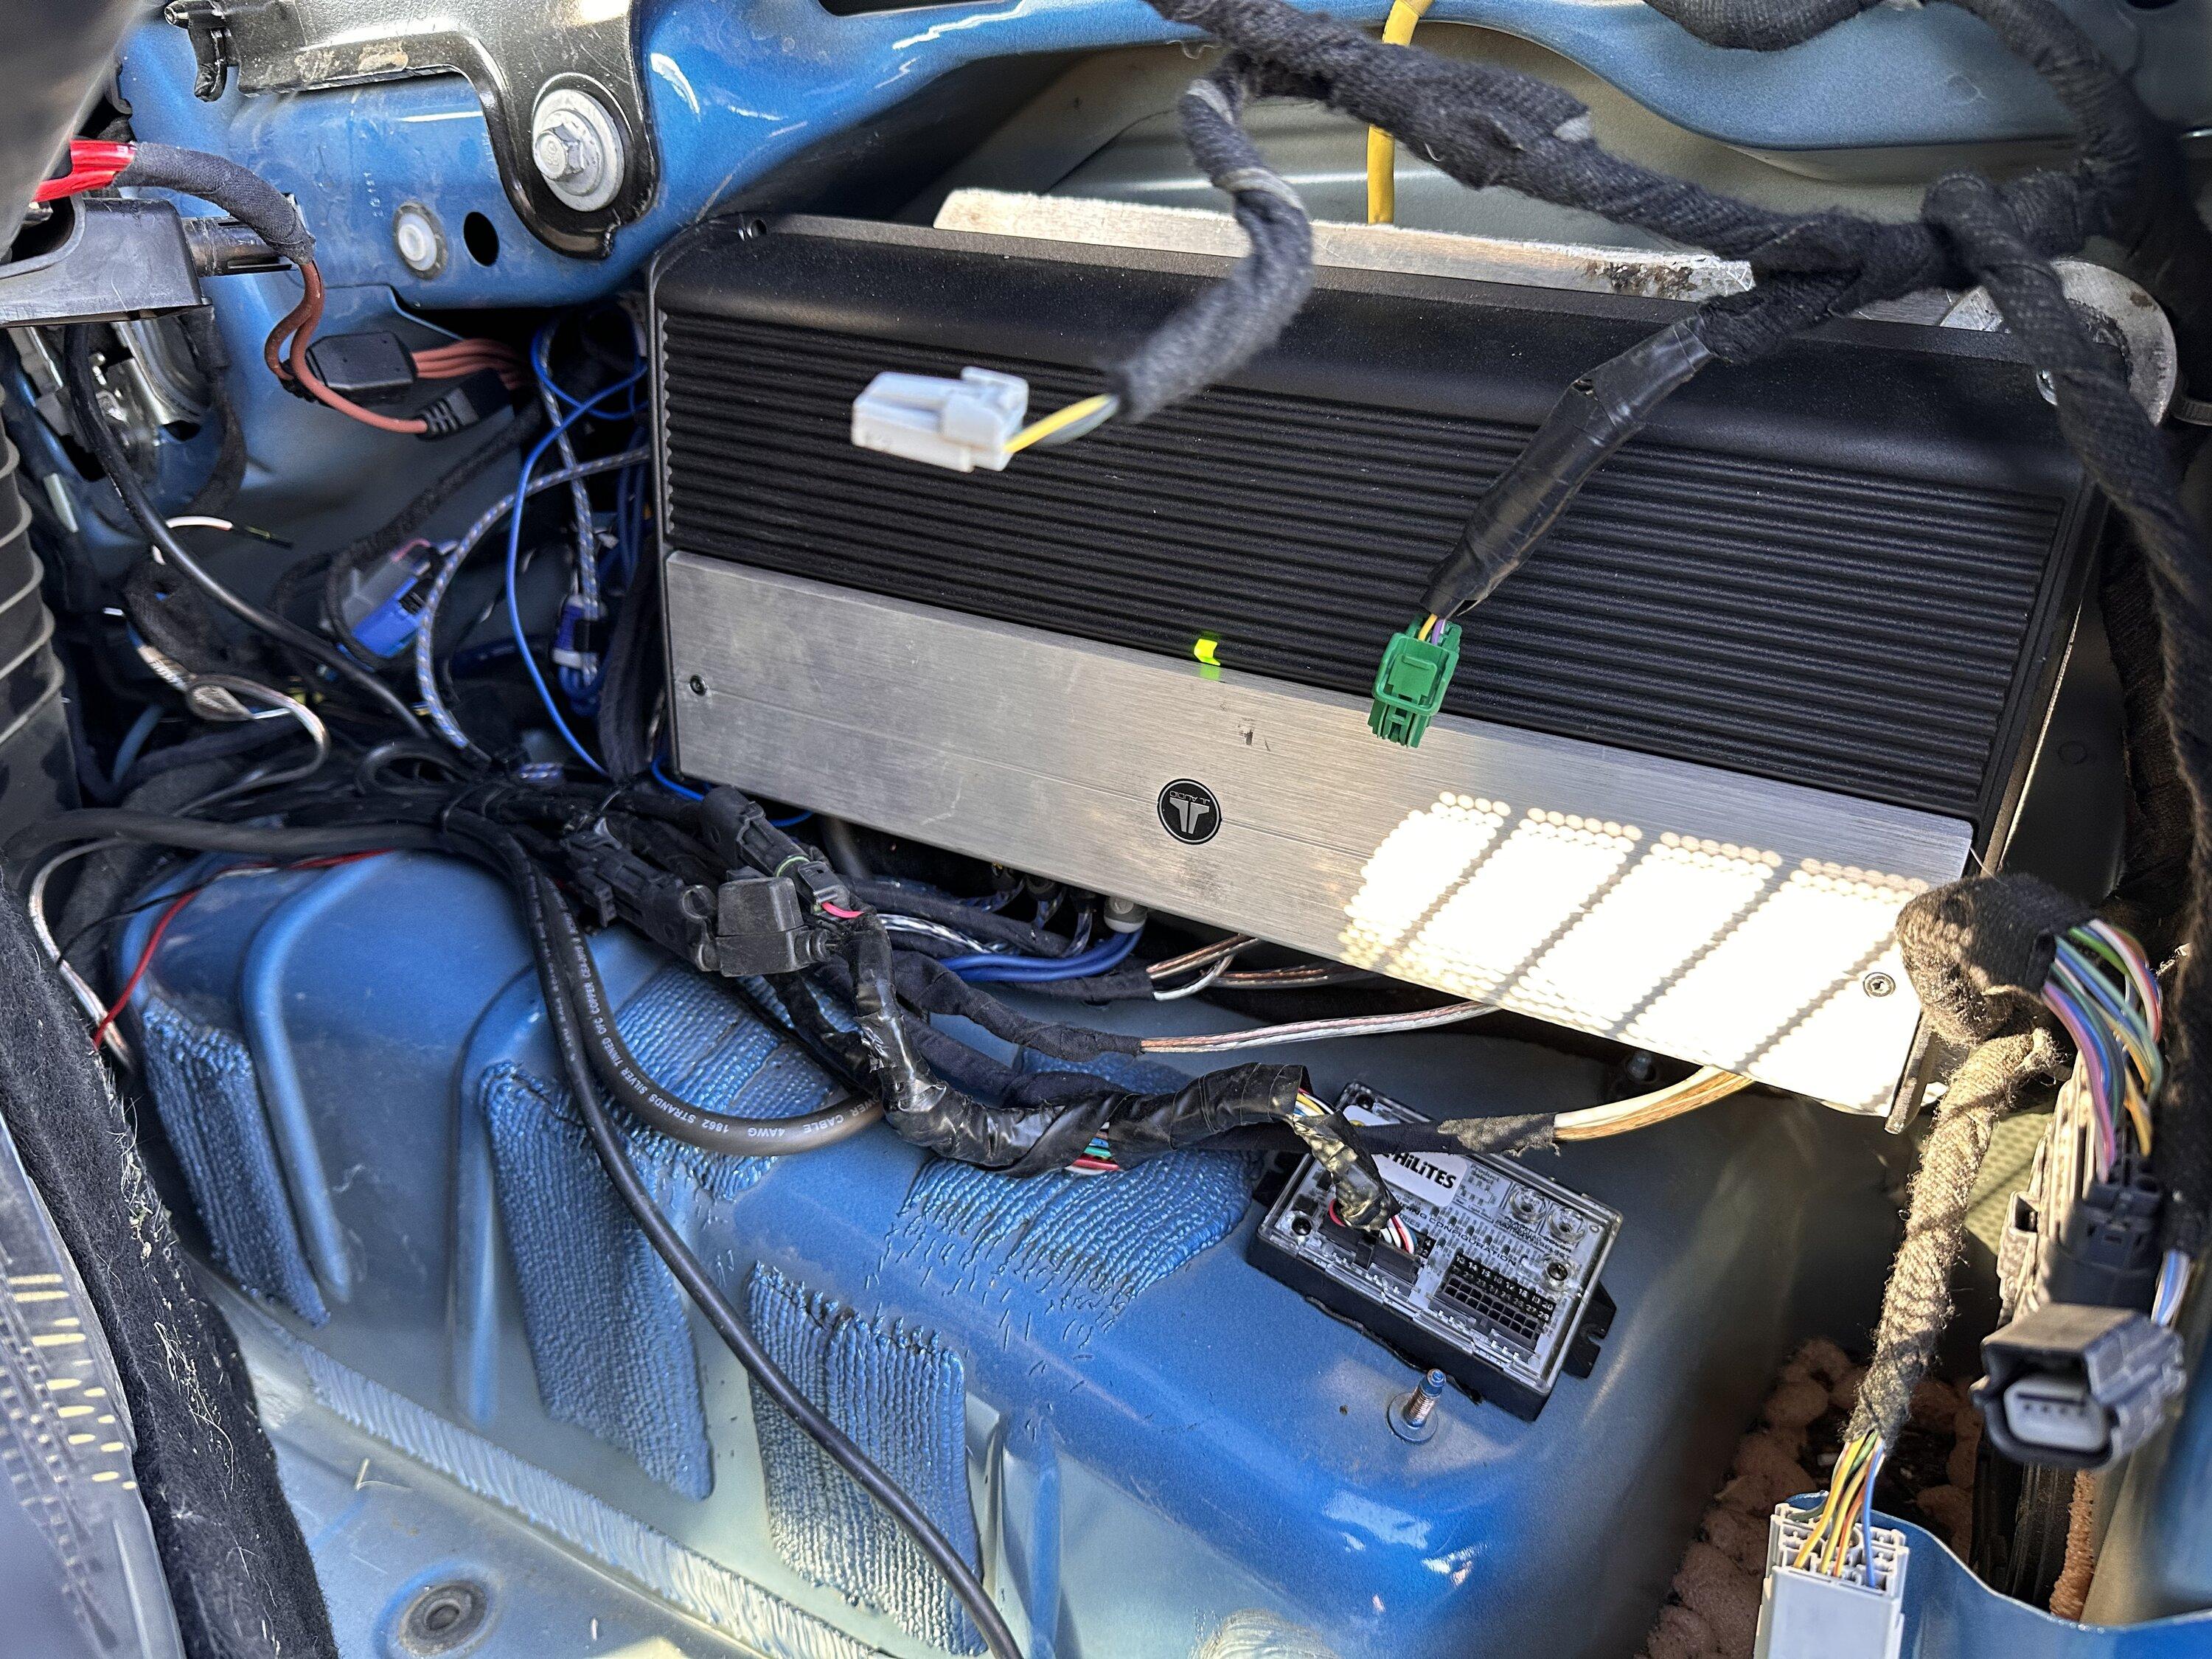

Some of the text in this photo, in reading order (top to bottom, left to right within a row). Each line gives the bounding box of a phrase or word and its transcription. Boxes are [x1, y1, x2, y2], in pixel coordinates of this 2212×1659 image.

[1169, 790, 1198, 801] AUDIO
[582, 981, 602, 1015] COPPER
[593, 1017, 608, 1035] OFC
[602, 1035, 625, 1068] TINNED
[619, 1066, 648, 1098] SILVER
[649, 1093, 698, 1124] STRANDS
[850, 1093, 880, 1116] OWER
[701, 1118, 730, 1133] 1862
[747, 1127, 786, 1138] 4AWG
[802, 1113, 844, 1134] CABLE
[1383, 1152, 1457, 1189] HiLiTES
[1429, 1217, 1517, 1267] CONFIGURATION
[1481, 1268, 1490, 1277] 15
[1518, 1288, 1528, 1298] 18
[1531, 1295, 1540, 1304] 19
[1542, 1301, 1554, 1311] 20
